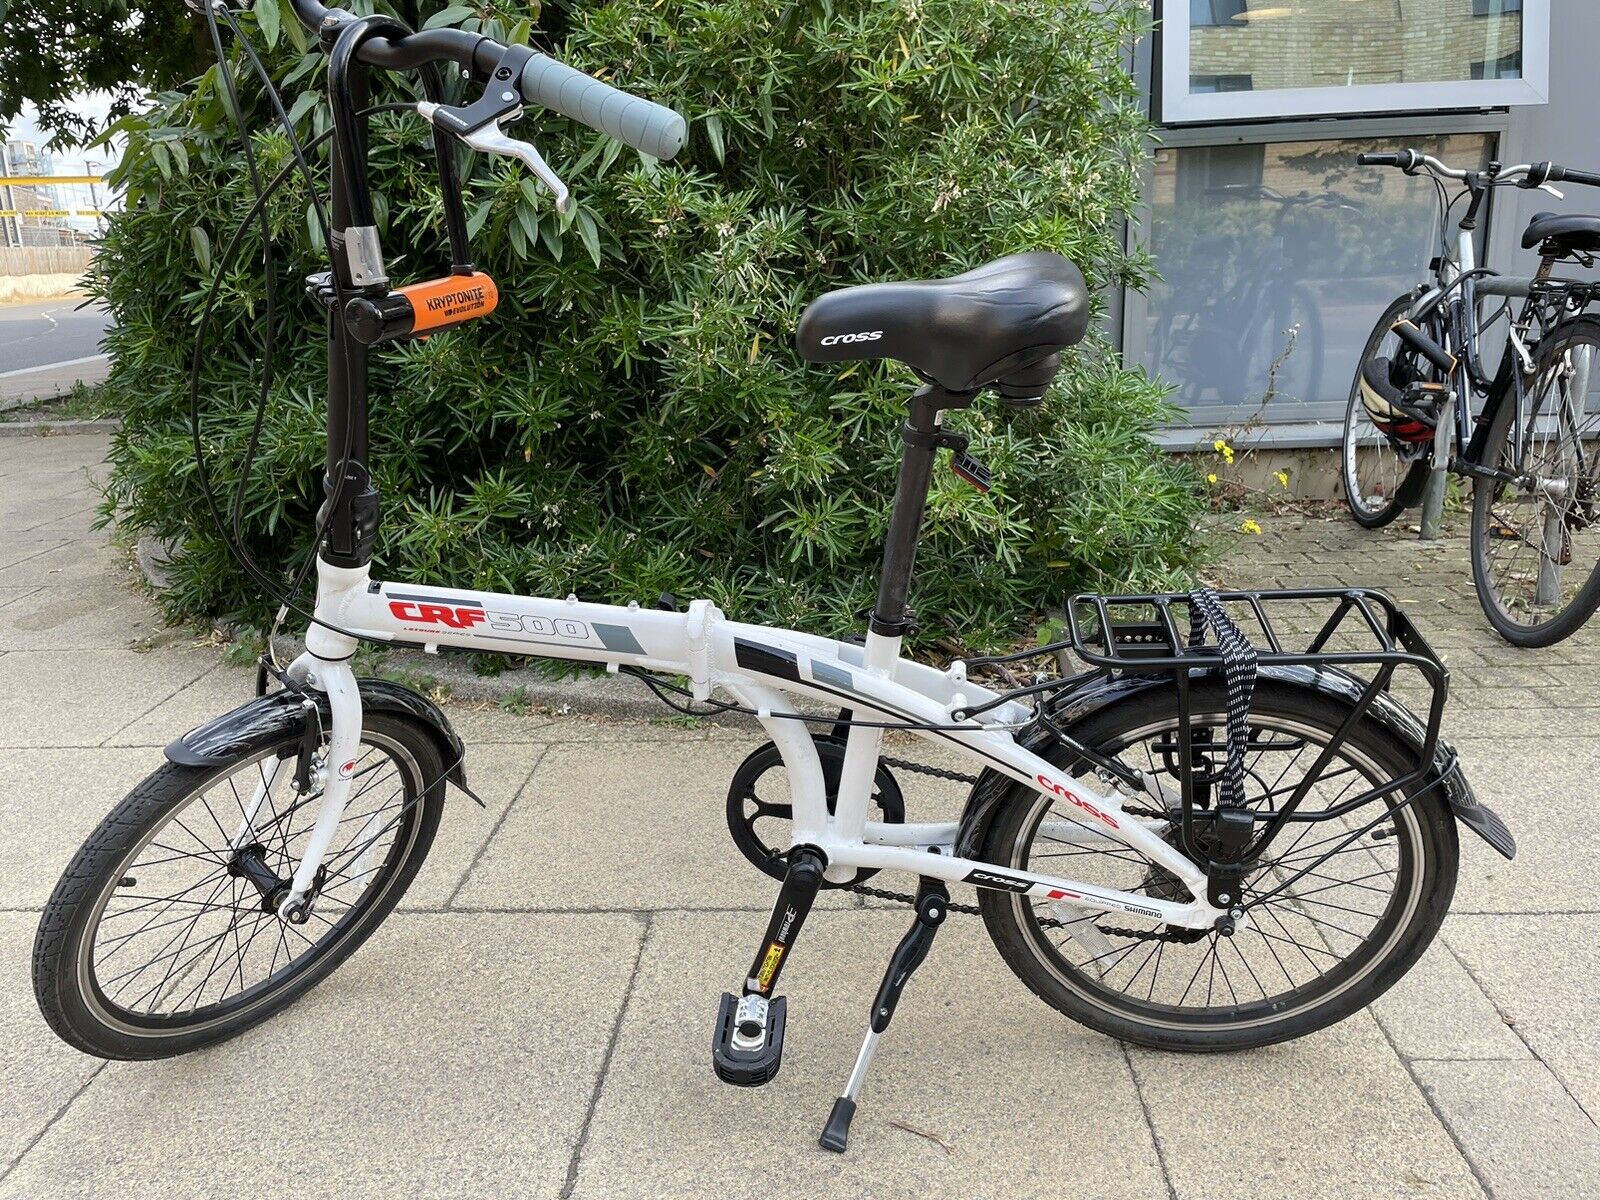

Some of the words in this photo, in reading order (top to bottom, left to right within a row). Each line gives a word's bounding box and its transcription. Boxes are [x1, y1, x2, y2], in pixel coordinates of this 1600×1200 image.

[426, 287, 485, 312] KRYPTONITE
[820, 330, 884, 346] cross
[1036, 774, 1120, 829] cross
[973, 873, 1029, 888] cross
[1124, 905, 1163, 919] SHIMANO
